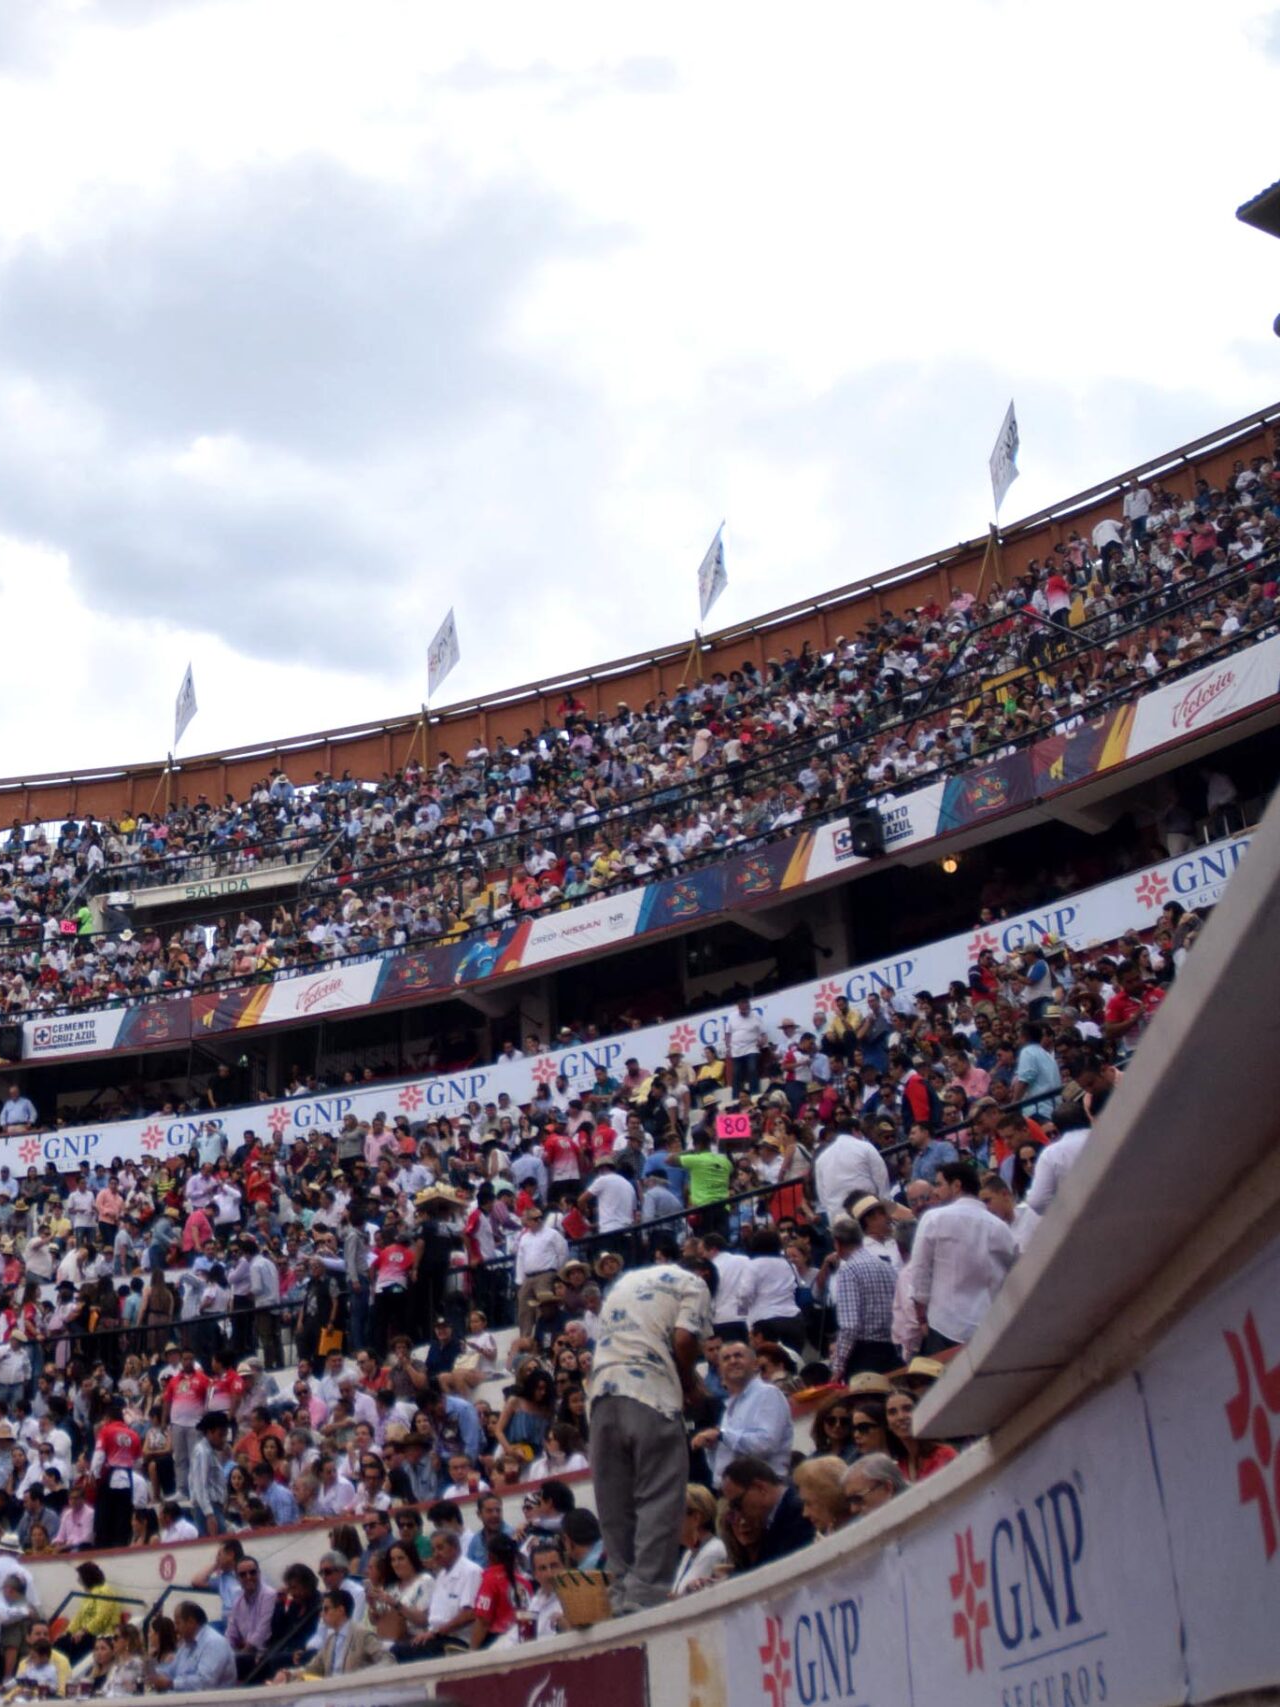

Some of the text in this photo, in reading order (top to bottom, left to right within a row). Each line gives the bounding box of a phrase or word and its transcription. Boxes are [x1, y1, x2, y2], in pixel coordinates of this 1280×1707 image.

[1172, 670, 1235, 728] Victoria
[882, 806, 908, 824] ENTO
[886, 819, 913, 837] AZUL
[185, 879, 251, 900] SALIDA
[560, 919, 602, 937] NISSAN
[1002, 906, 1076, 953] GNP
[296, 975, 343, 1012] Victoria
[845, 960, 914, 1003] GNP
[51, 1030, 97, 1044] CRUZ AZUL
[52, 1020, 96, 1033] CEMENTO
[560, 1043, 622, 1078] GNP
[427, 1074, 486, 1106] GNP
[294, 1098, 352, 1127] GNP
[724, 1116, 747, 1135] 80
[44, 1134, 99, 1159] GNP
[991, 1479, 1083, 1650] GNP
[795, 1600, 860, 1707] GNP
